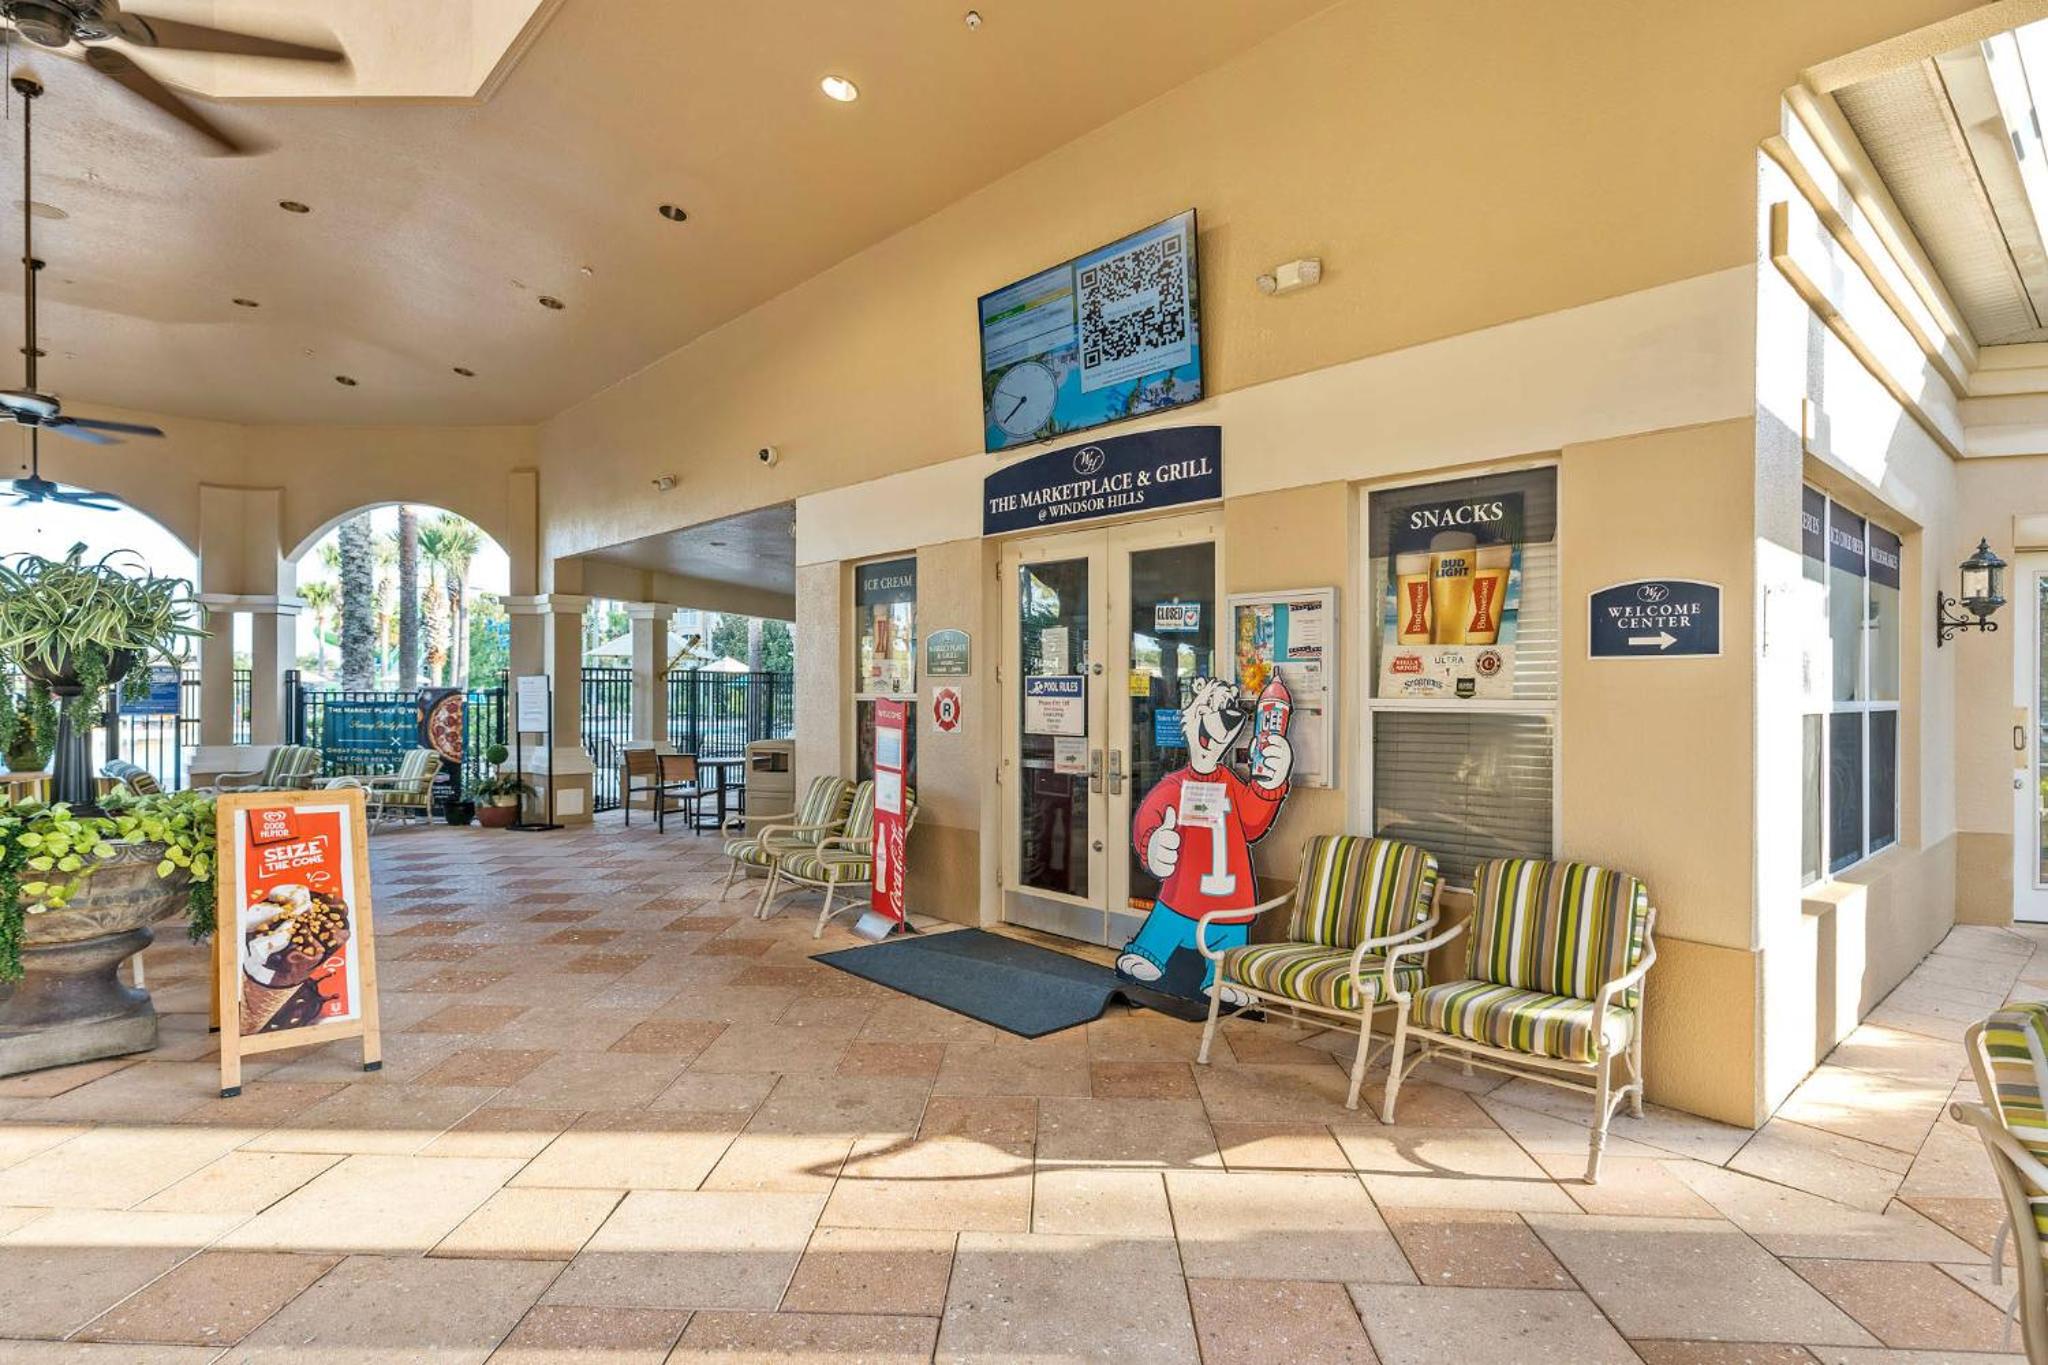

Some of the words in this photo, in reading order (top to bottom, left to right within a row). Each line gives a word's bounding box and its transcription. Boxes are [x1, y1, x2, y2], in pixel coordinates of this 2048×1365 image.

[990, 495, 1018, 514] THE
[1020, 473, 1133, 508] MARKETPLACE
[1137, 470, 1151, 486] &
[1156, 458, 1213, 483] GRILL
[1038, 509, 1047, 522] @
[1049, 498, 1106, 517] WINDSOR
[1108, 491, 1145, 508] HILLS
[1410, 501, 1503, 529] SNACKS
[1441, 559, 1466, 569] BUD
[1435, 567, 1469, 577] LIGHT
[863, 578, 879, 591] ICE
[880, 574, 912, 589] CREAM
[1157, 606, 1183, 620] CLOSED
[1608, 603, 1701, 619] WELCOME
[1617, 616, 1691, 629] CENTER
[1434, 655, 1464, 664] ULTRA
[1044, 681, 1059, 692] POOL
[1059, 681, 1078, 692] RULES
[943, 703, 951, 717] R
[263, 821, 286, 830] GOOD
[260, 829, 289, 838] HUMOR
[264, 841, 322, 862] SEIZE
[265, 860, 291, 871] THE
[292, 854, 324, 867] CONE
